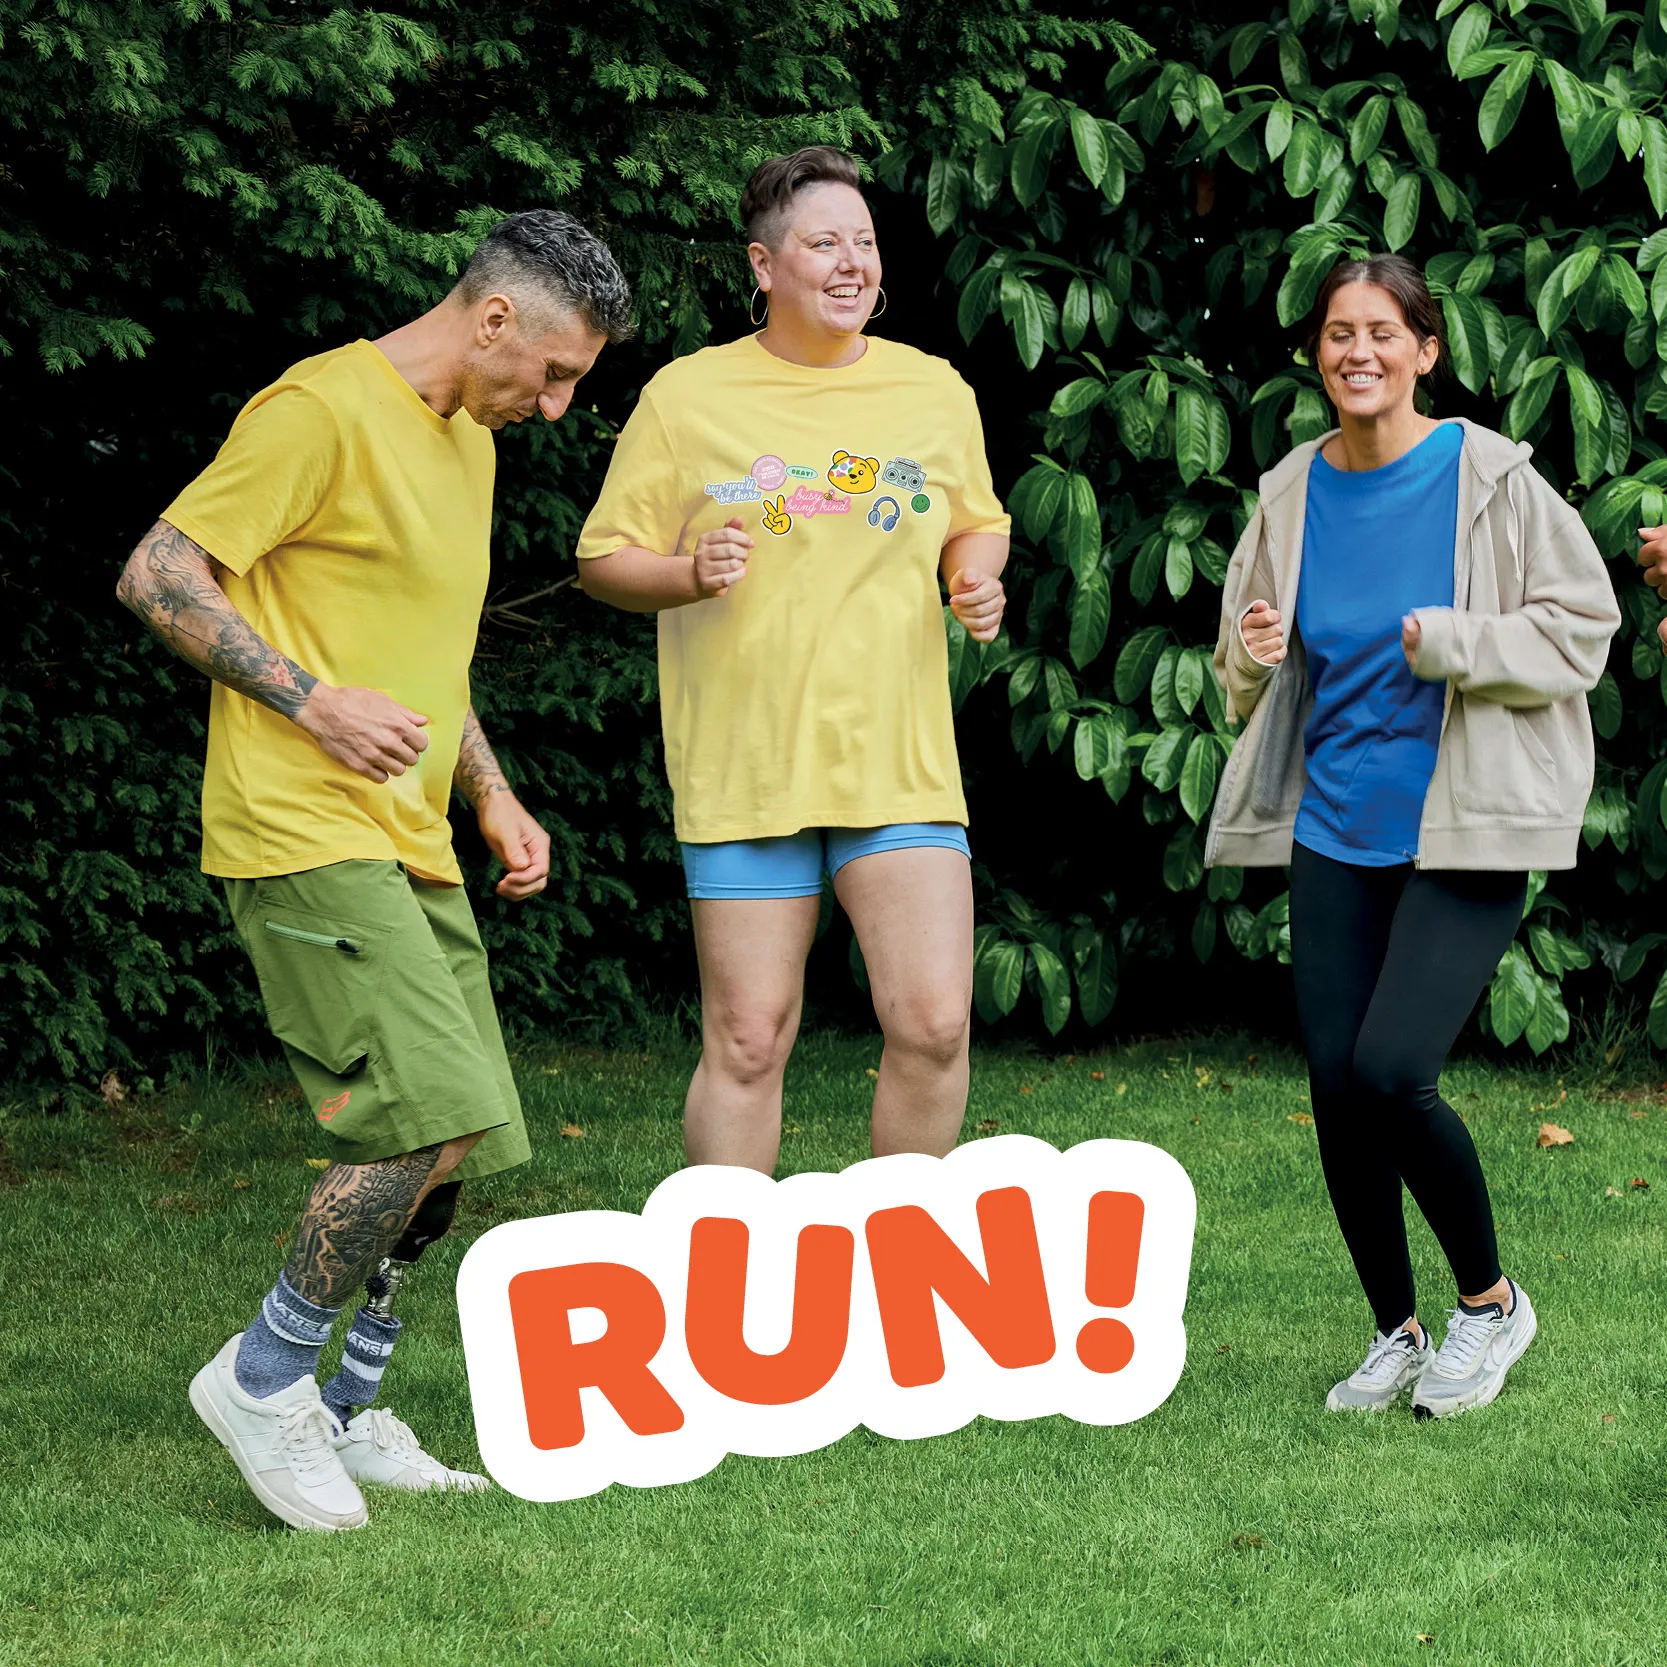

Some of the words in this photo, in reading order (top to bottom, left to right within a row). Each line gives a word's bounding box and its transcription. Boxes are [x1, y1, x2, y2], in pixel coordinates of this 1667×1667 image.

[791, 468, 814, 477] OKAY!
[706, 485, 725, 497] say
[725, 476, 756, 495] you'll
[720, 493, 732, 503] be
[734, 490, 761, 501] there
[795, 487, 824, 505] busy
[785, 498, 817, 517] being
[819, 498, 849, 512] kind
